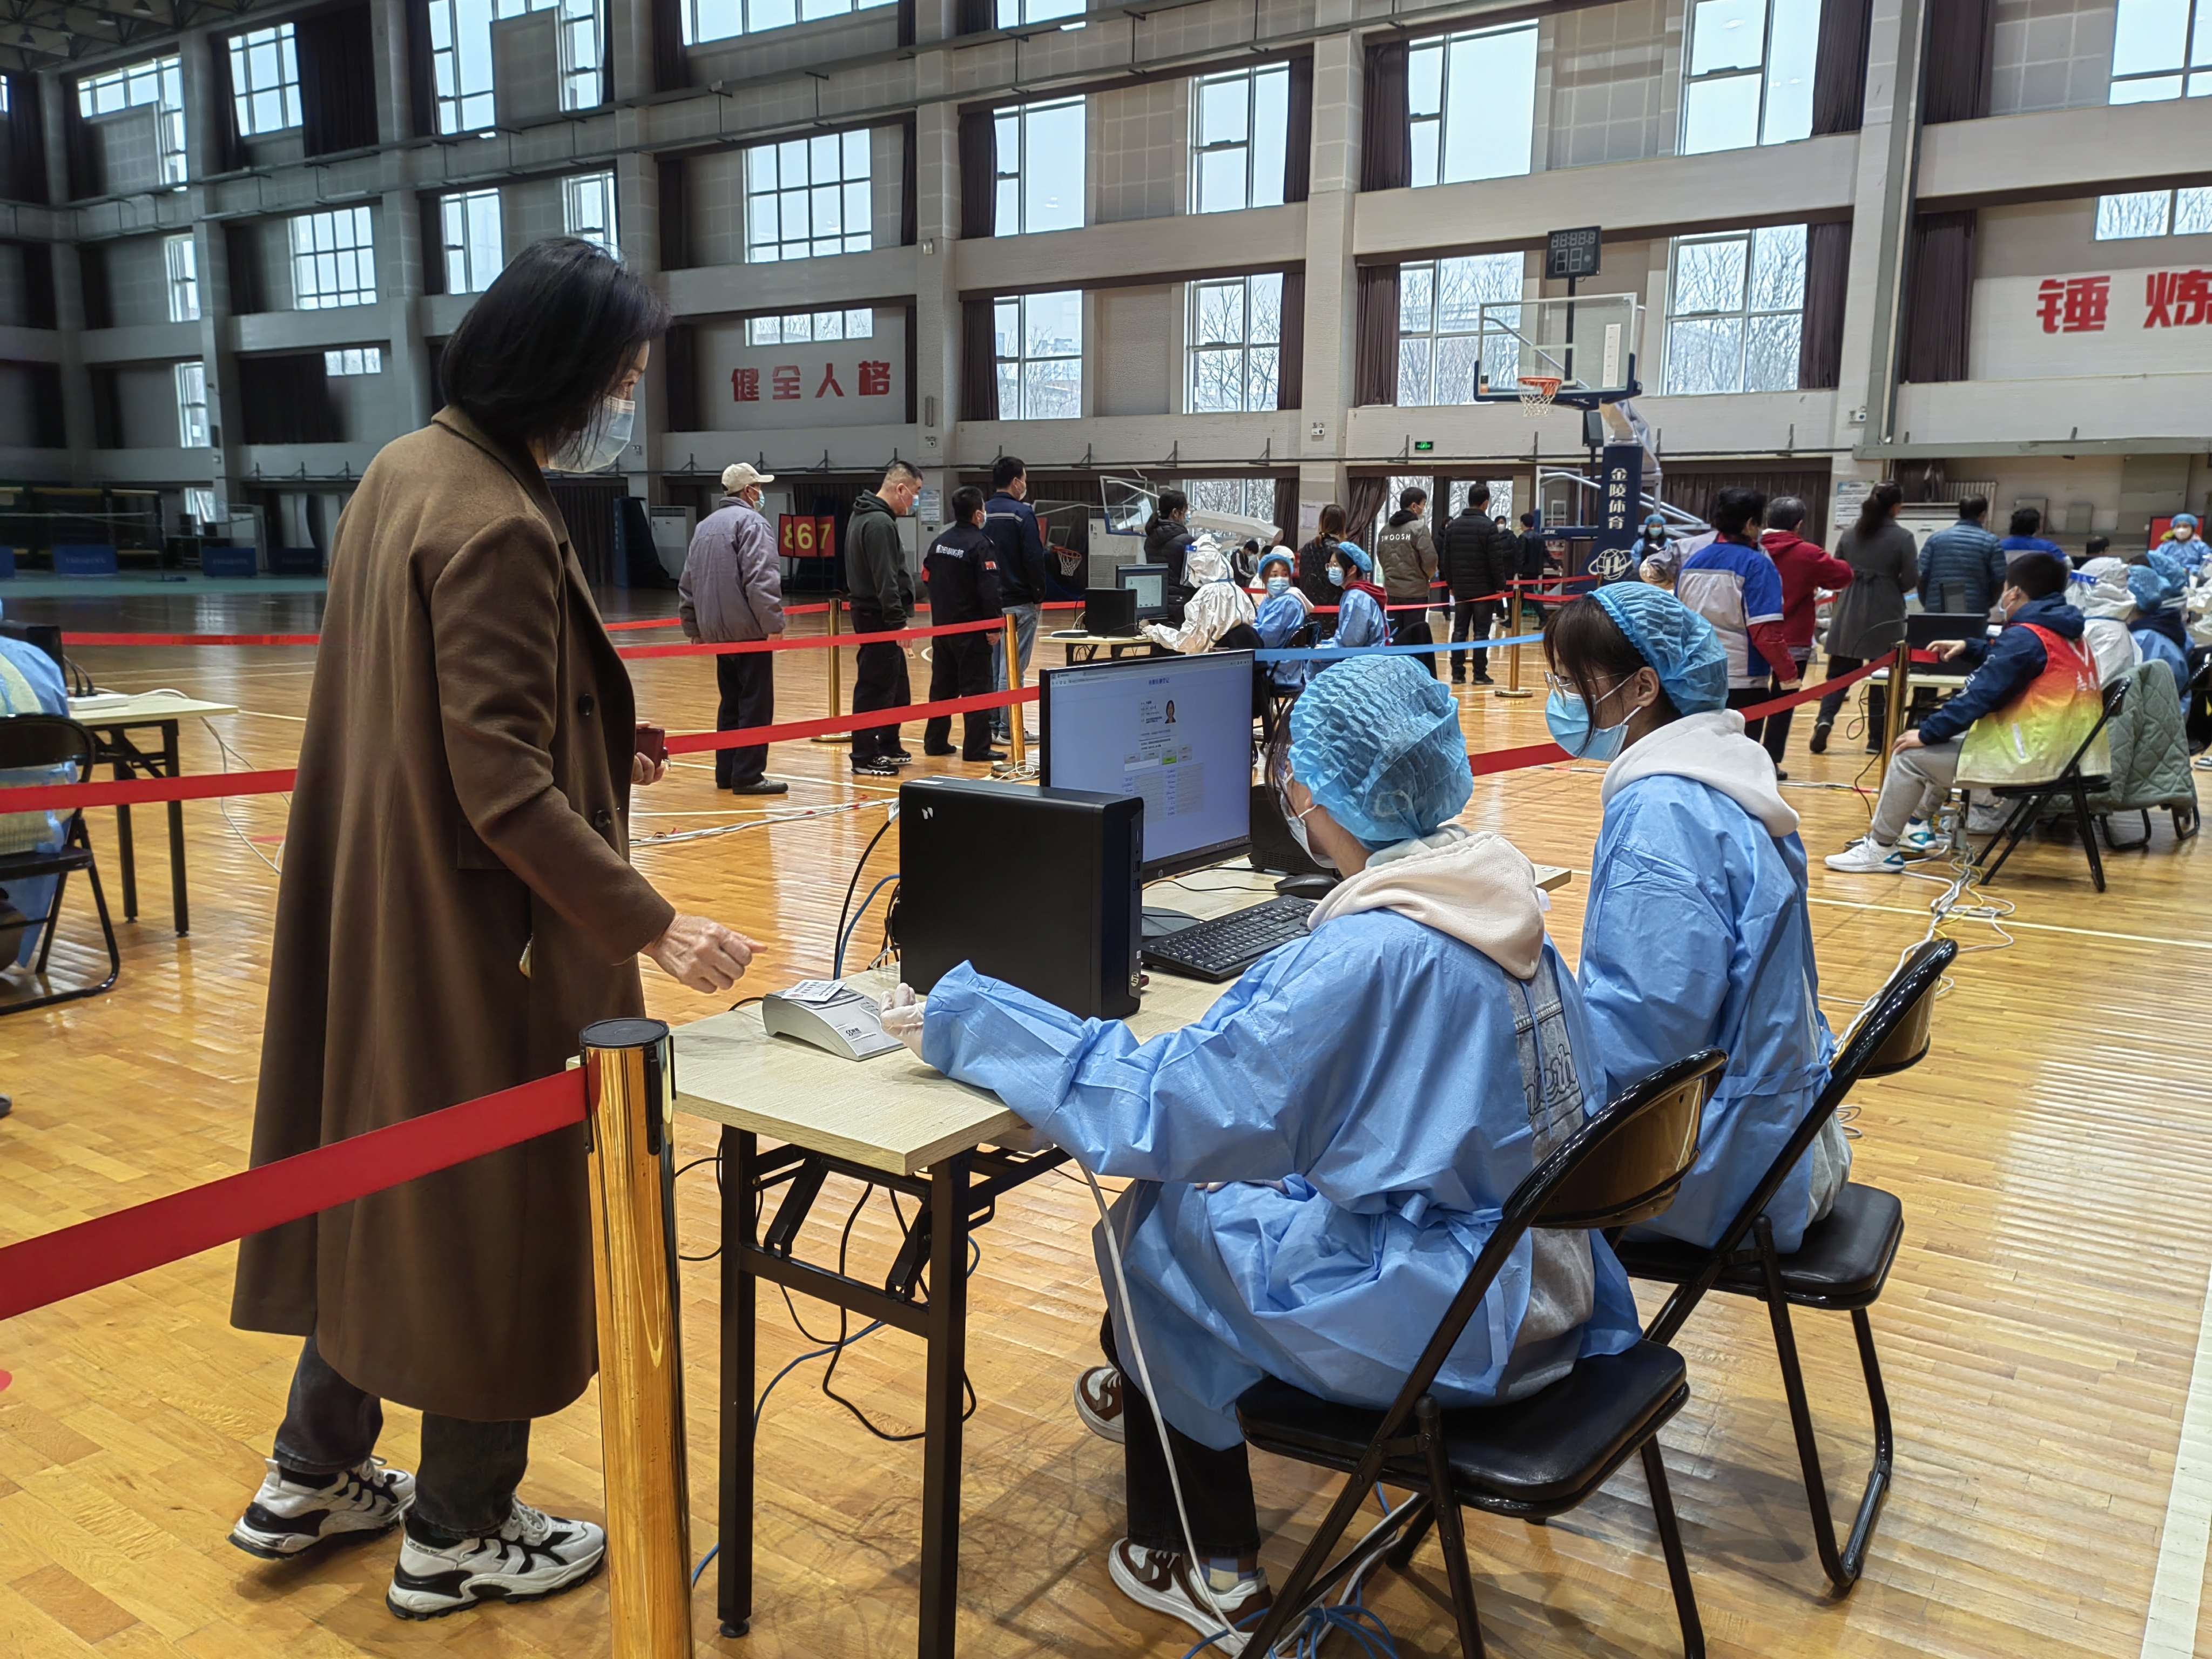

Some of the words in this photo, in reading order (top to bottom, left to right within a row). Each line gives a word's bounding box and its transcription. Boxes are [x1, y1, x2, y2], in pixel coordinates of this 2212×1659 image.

[731, 360, 890, 402] 健全人格
[1608, 468, 1628, 529] 金陵体育
[784, 523, 831, 549] 867
[1131, 972, 1139, 987] hp
